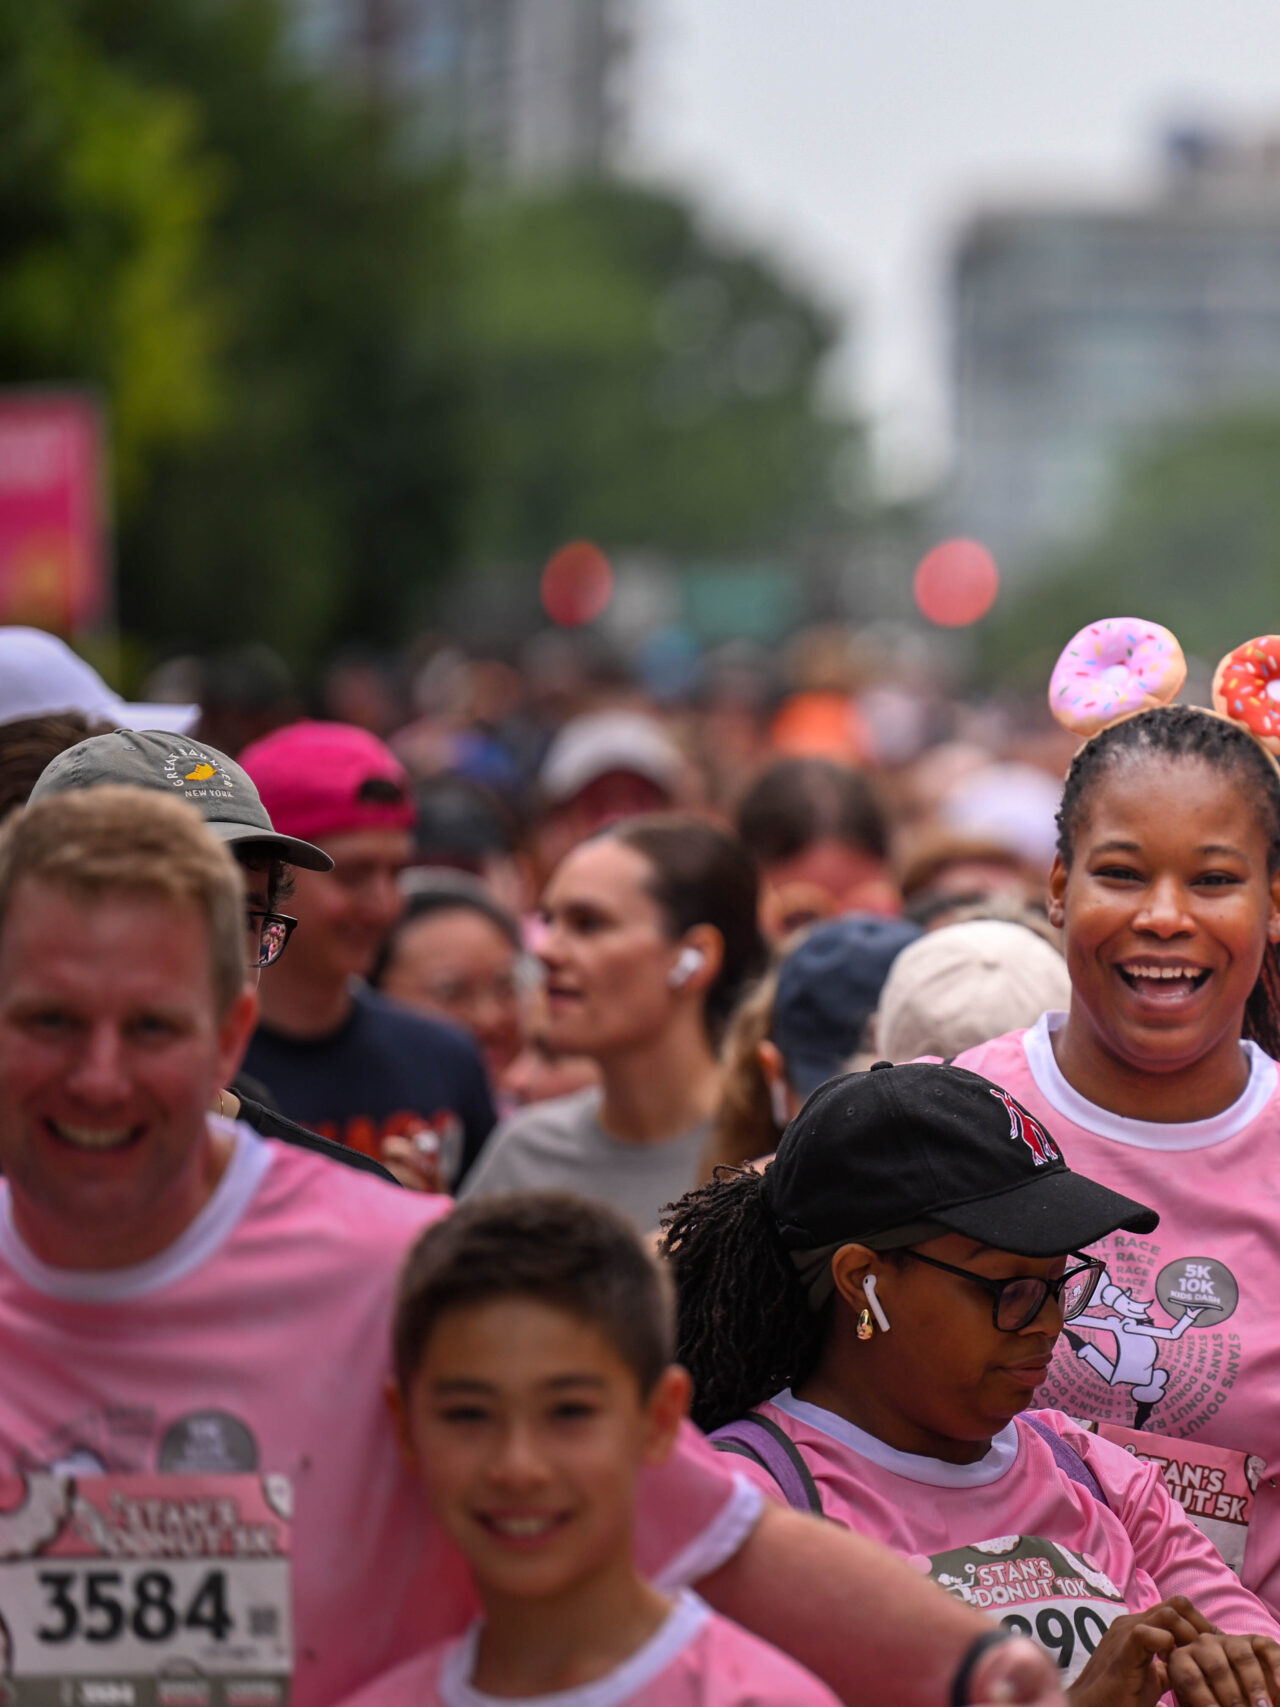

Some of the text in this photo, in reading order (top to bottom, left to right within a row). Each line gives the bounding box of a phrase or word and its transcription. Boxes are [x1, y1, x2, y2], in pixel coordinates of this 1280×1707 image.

[164, 752, 184, 787] GREAT
[185, 789, 235, 798] NEW YORK
[1114, 1235, 1161, 1256] RACE
[1116, 1251, 1156, 1267] RACE
[1116, 1265, 1150, 1277] RACE
[1185, 1263, 1213, 1280] 5K
[1170, 1290, 1221, 1304] KIDS DASH
[1178, 1277, 1216, 1295] 10K
[1166, 1369, 1187, 1393] DON
[1170, 1333, 1223, 1424] STAN'S DONUT
[1179, 1333, 1241, 1438] STAN'S DONUT
[1163, 1375, 1198, 1410] DONUT
[1138, 1455, 1225, 1492] AN'S
[1214, 1494, 1248, 1522] 5K
[979, 1560, 1053, 1586] STAN'S
[974, 1578, 1092, 1608] DONUT 10K
[37, 1569, 233, 1644] 3584
